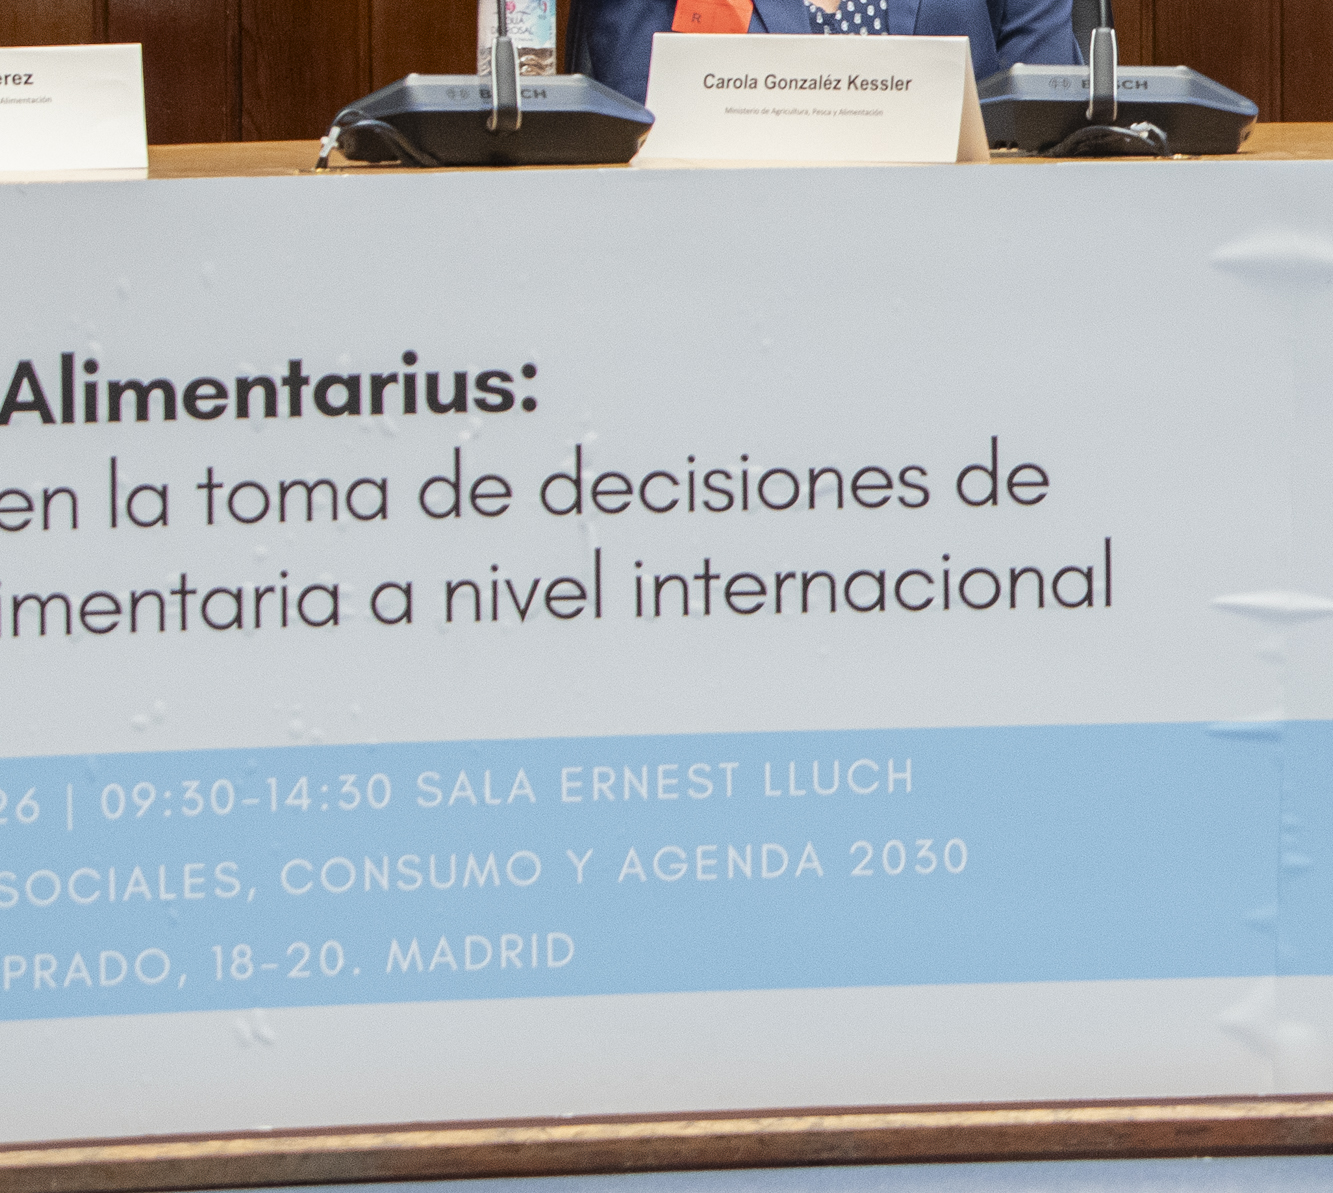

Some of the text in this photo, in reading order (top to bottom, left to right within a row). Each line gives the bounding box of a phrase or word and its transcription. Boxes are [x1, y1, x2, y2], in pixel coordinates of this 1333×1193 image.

[0, 73, 34, 86] rez
[479, 88, 548, 99] BCH
[702, 72, 913, 92] Carola Gonzaléz Kessler
[724, 106, 760, 116] Ministerio
[761, 106, 770, 116] de
[812, 107, 832, 117] Pesca
[0, 350, 538, 427] Alimentarius:
[0, 435, 1051, 533] en la toma de decisiones de
[369, 580, 414, 626] a
[444, 548, 603, 624] nivel
[633, 536, 1113, 619] internacional
[100, 773, 392, 820] 09:30-14:30
[416, 769, 536, 808] SALA
[561, 762, 739, 803] ERNEST
[764, 758, 912, 797] LLUCH
[0, 838, 969, 908] SOCIALES, CONSUMO Y AGENDA 2030
[3, 932, 575, 991] PRADO, 18-20. MADRID
